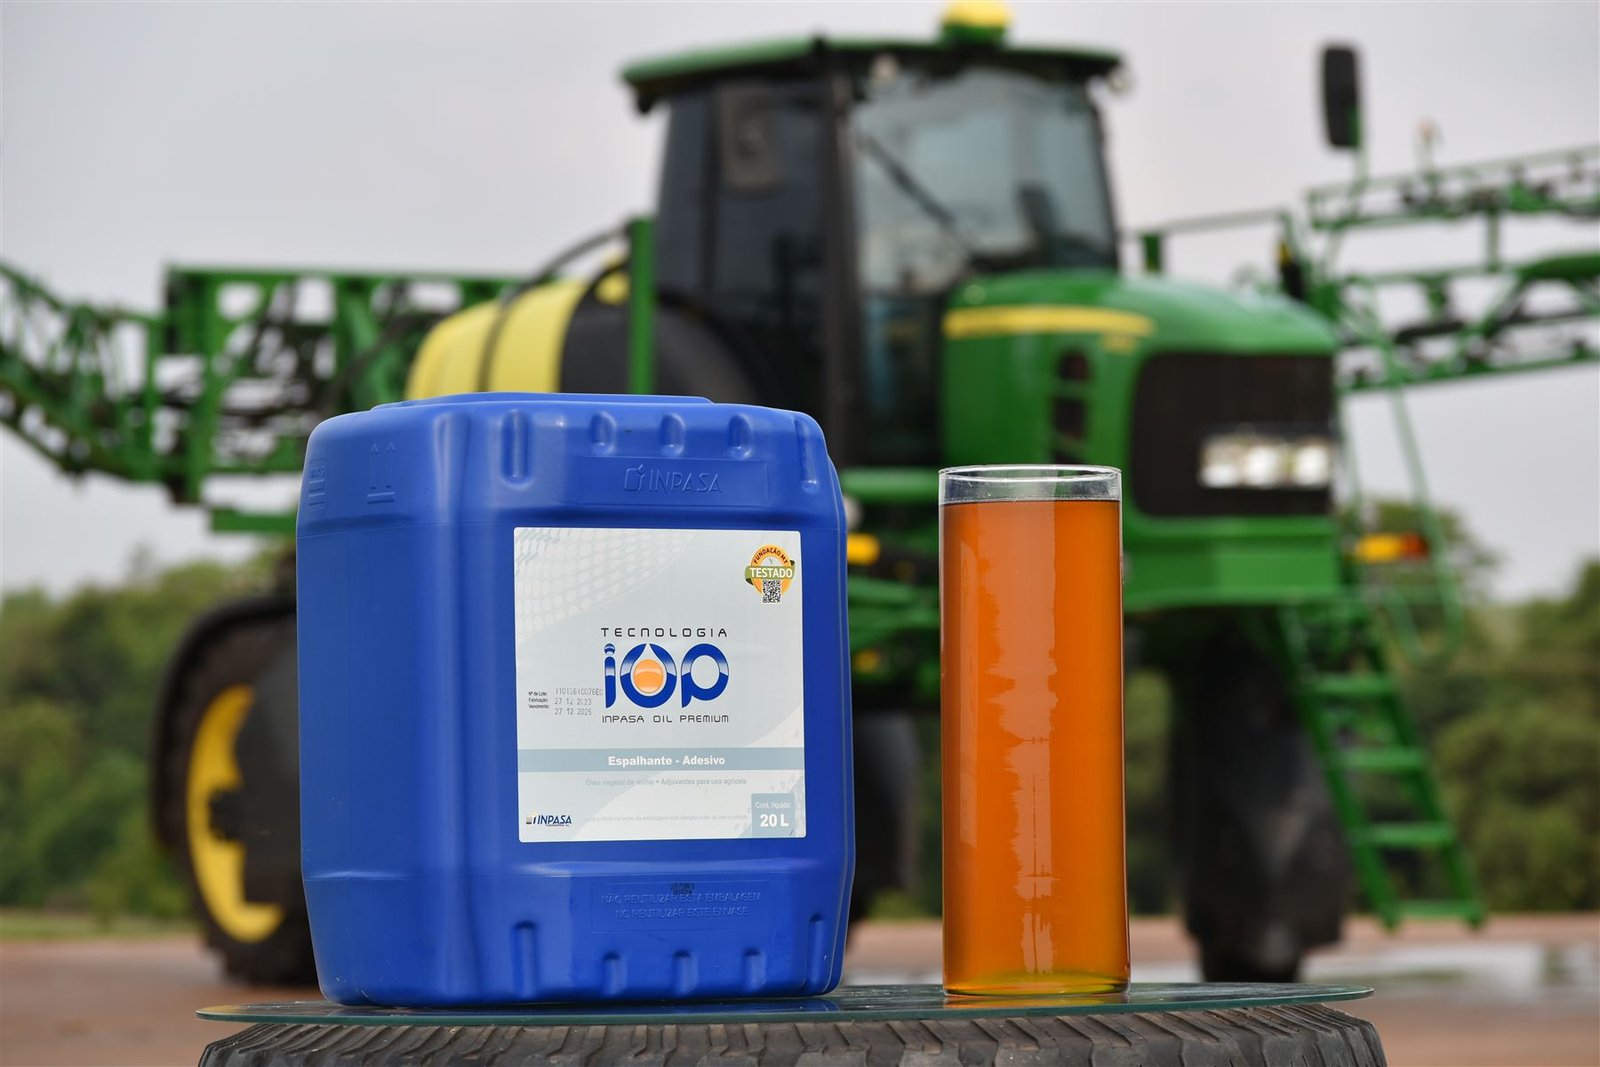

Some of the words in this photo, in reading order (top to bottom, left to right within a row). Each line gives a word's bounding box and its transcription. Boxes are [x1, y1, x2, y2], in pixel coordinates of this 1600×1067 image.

[650, 469, 722, 495] INPASA
[750, 567, 793, 578] TESTADO
[600, 627, 728, 638] TECNOLOGIA
[566, 708, 574, 716] 12
[601, 715, 645, 724] INPASA
[652, 715, 673, 723] OIL
[679, 714, 729, 723] PREMIUM
[608, 756, 673, 768] Espalhante
[682, 755, 726, 766] Adesivo
[537, 814, 573, 825] INPASA
[759, 814, 778, 827] 20
[780, 814, 790, 827] L
